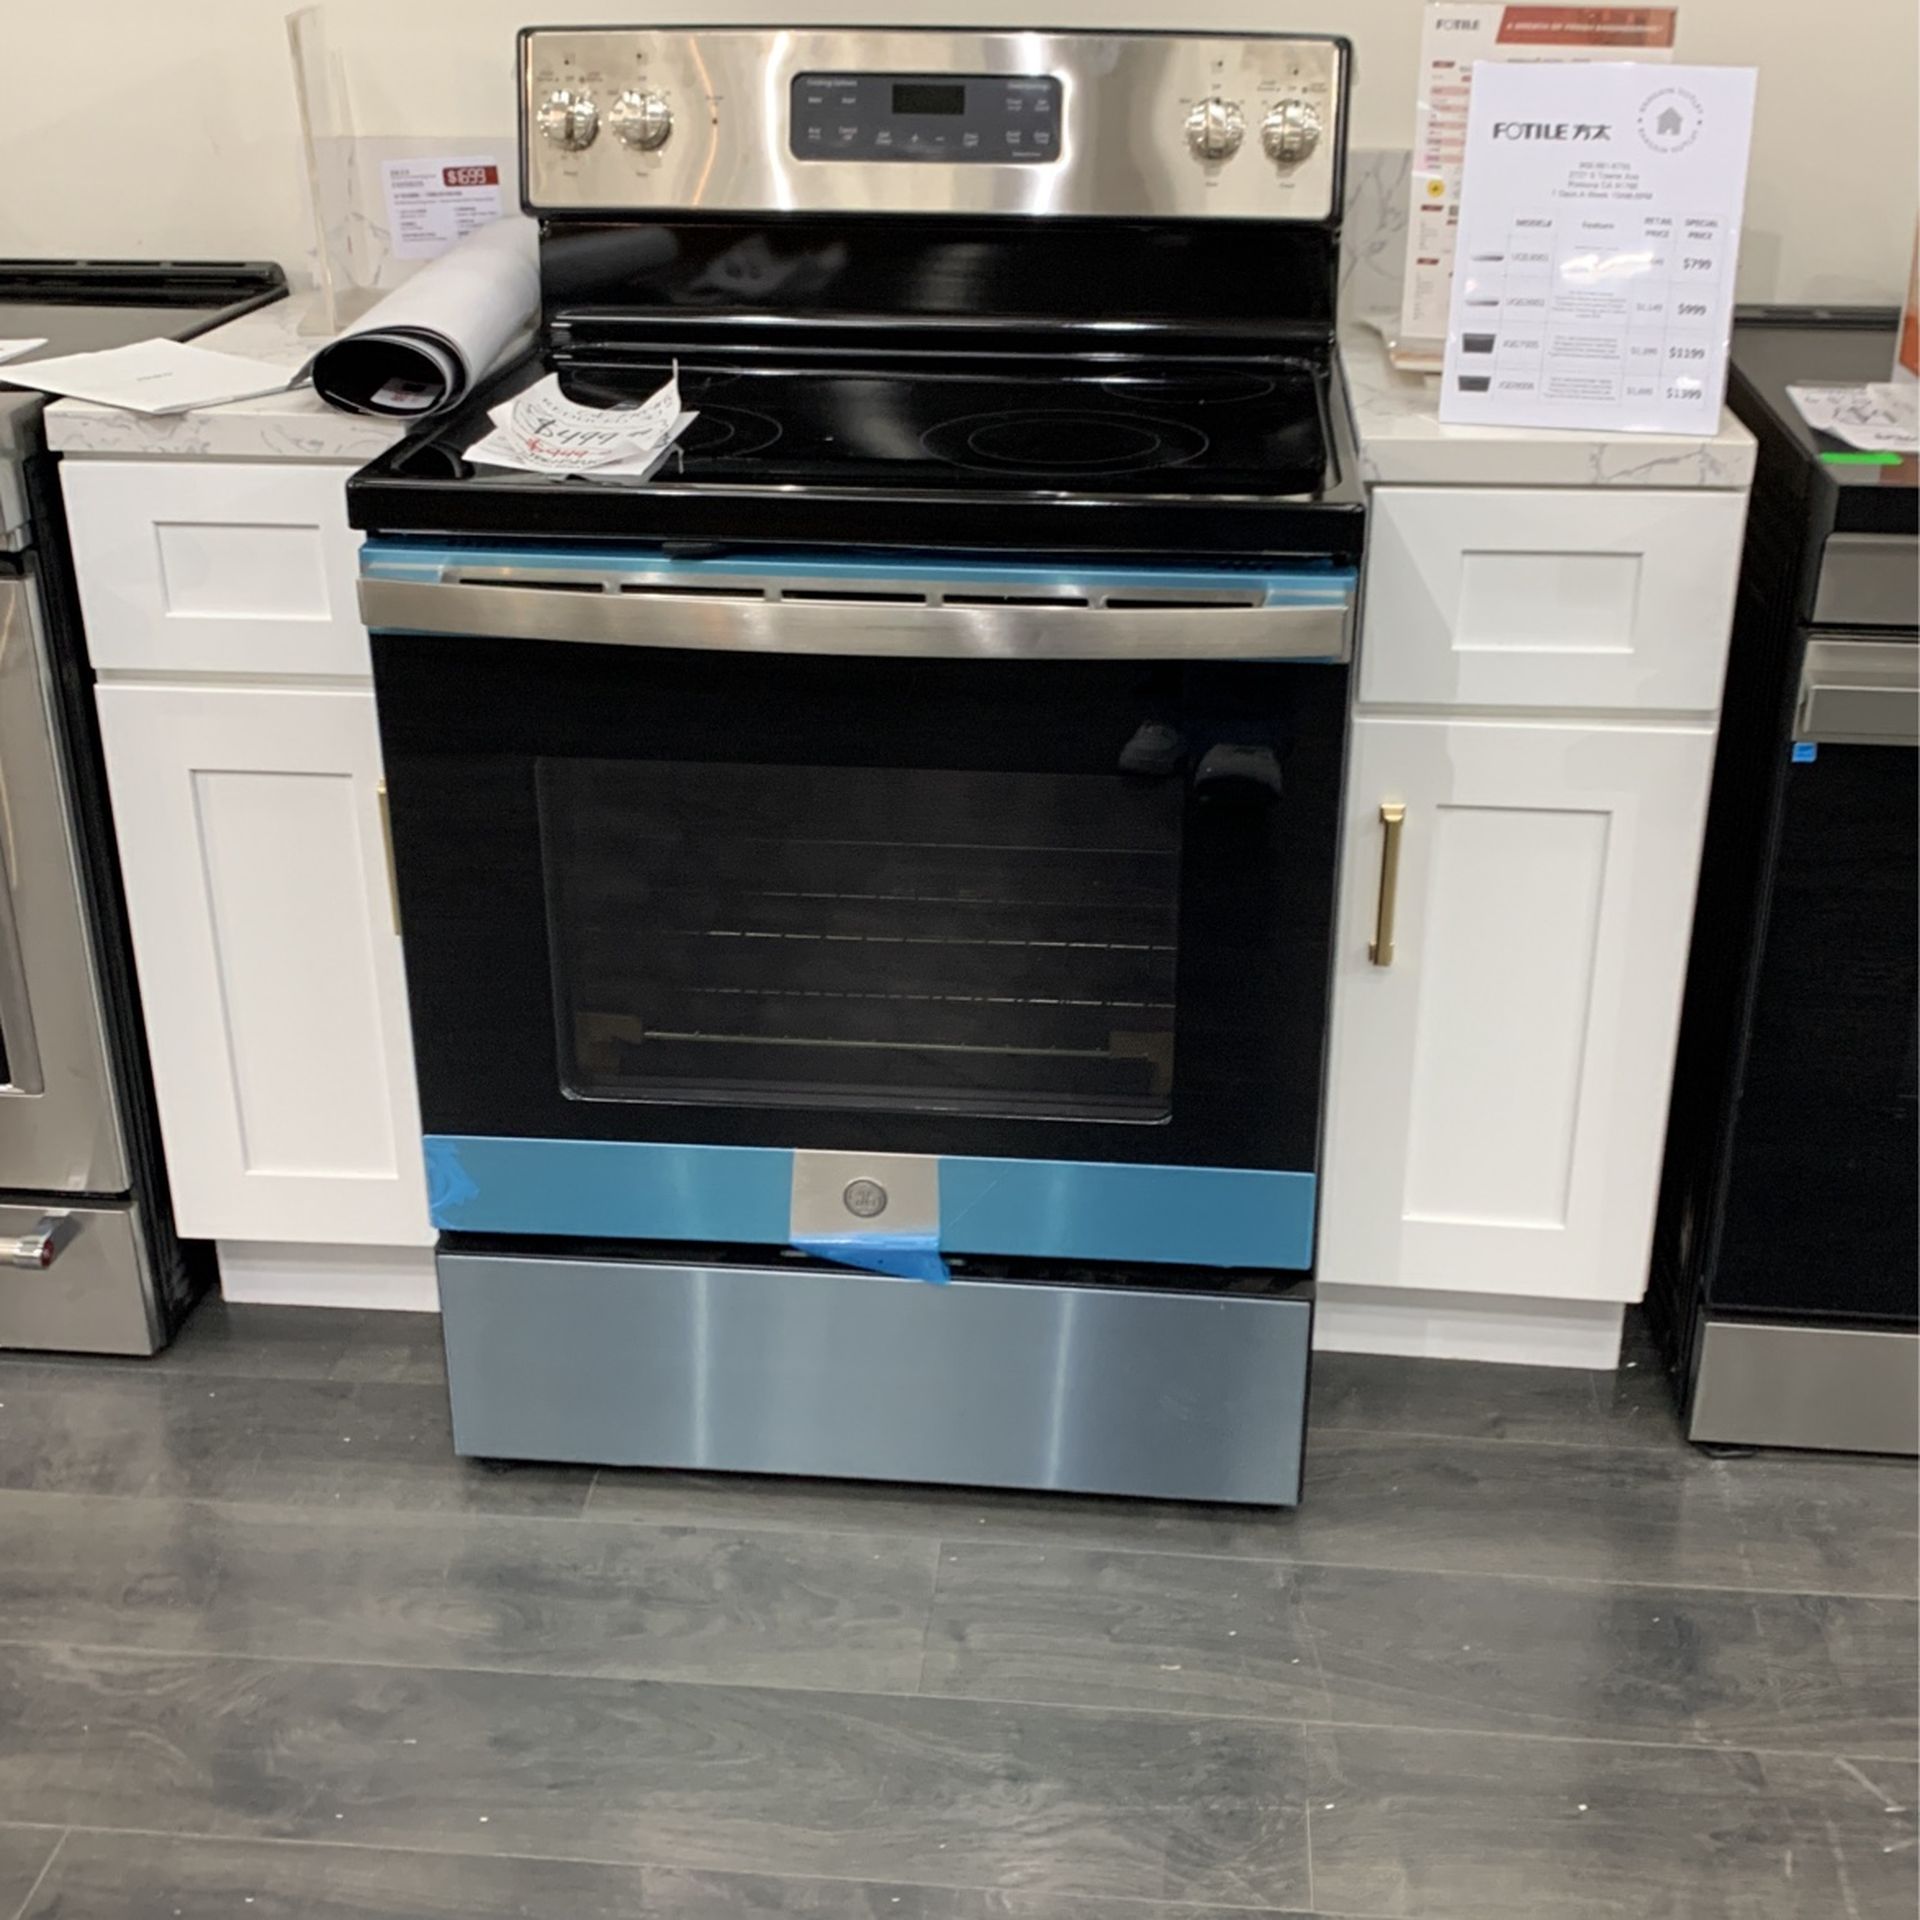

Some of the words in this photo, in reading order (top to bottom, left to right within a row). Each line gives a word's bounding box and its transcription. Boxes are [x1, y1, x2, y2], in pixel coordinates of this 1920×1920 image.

[1436, 19, 1480, 31] FOTILE
[1493, 121, 1569, 141] FOTILE
[1572, 123, 1612, 141] 方太
[1683, 257, 1712, 270] $799
[1677, 302, 1707, 316] $999
[1668, 345, 1705, 360] $1199
[1666, 387, 1702, 400] $1399
